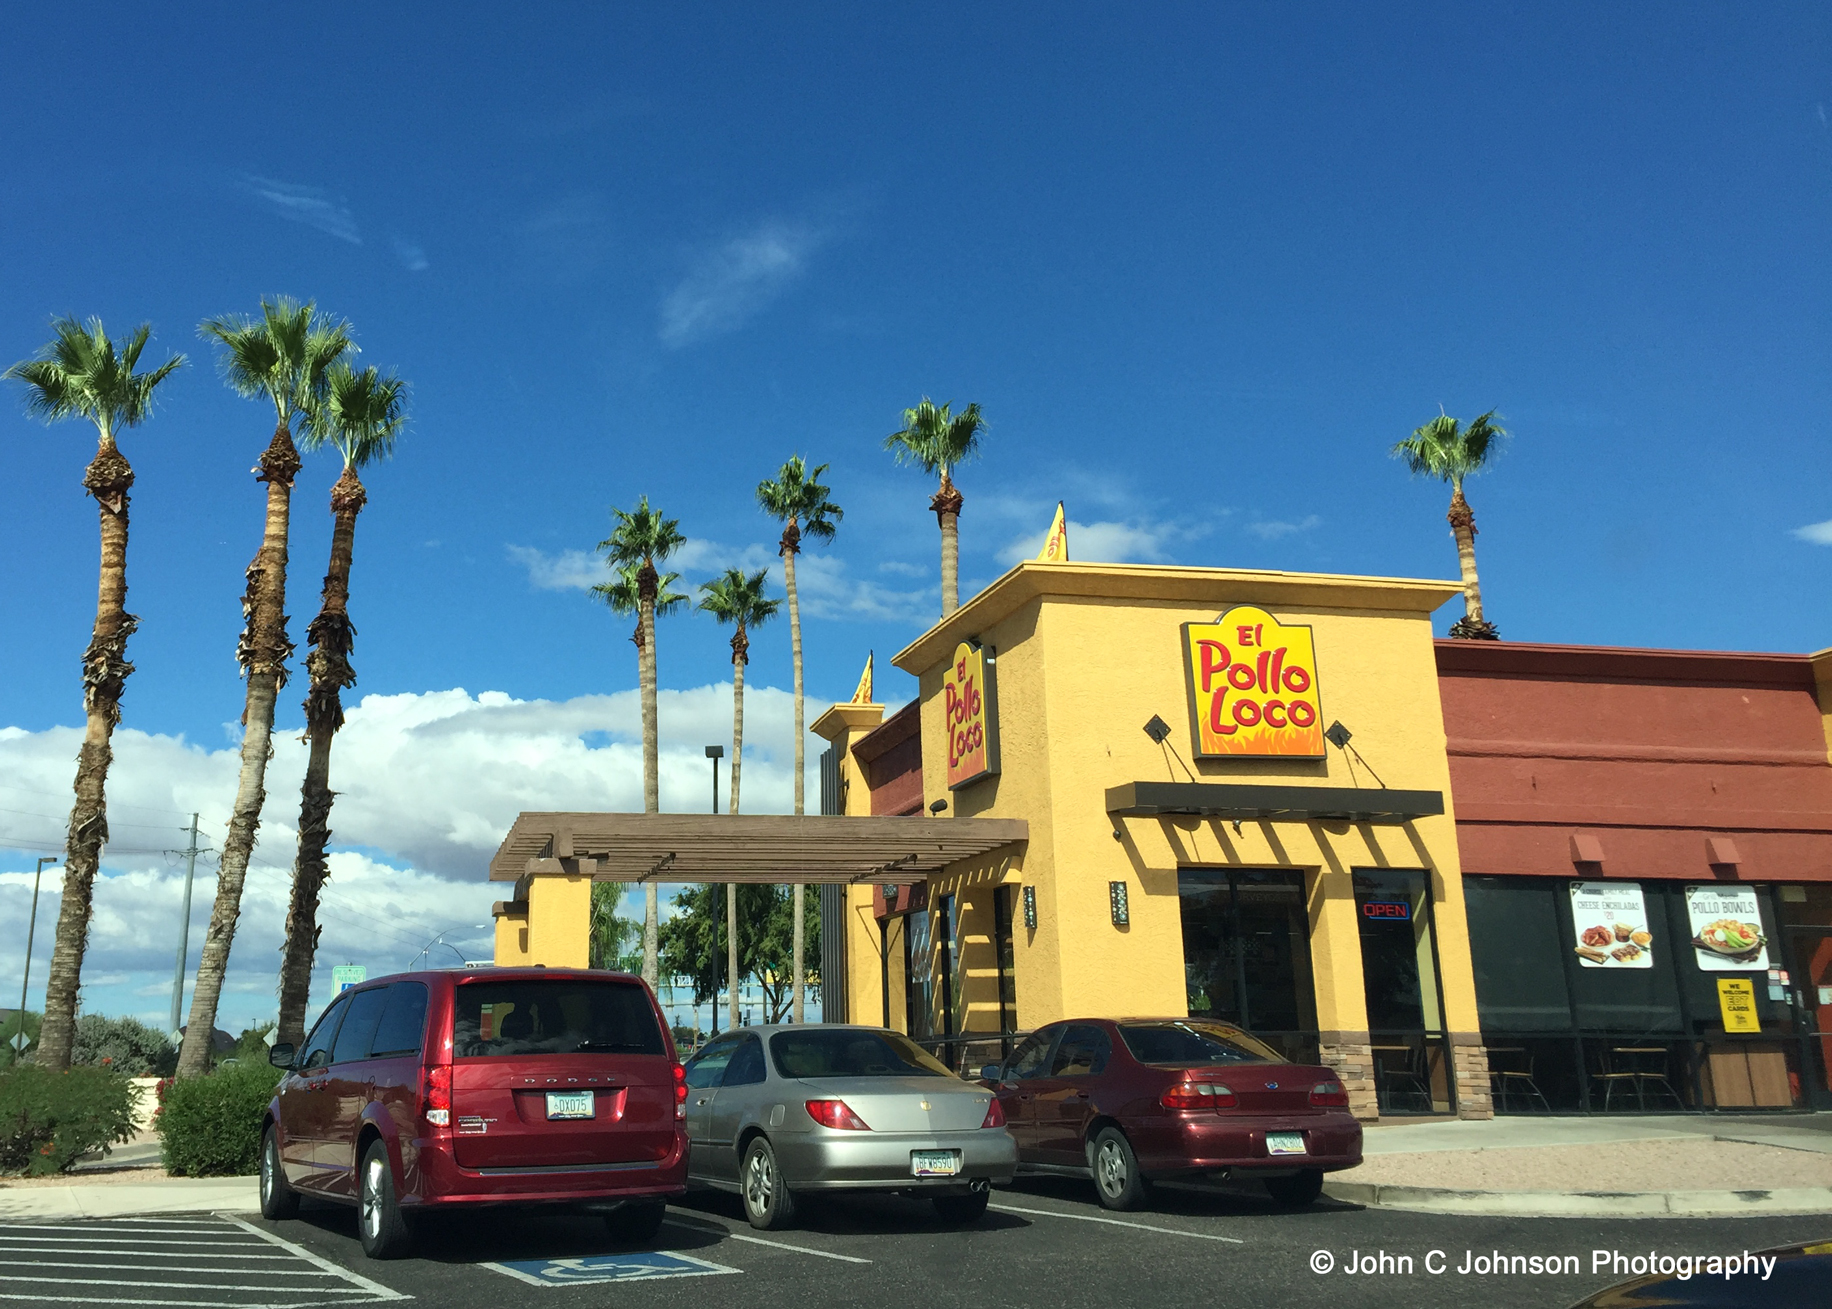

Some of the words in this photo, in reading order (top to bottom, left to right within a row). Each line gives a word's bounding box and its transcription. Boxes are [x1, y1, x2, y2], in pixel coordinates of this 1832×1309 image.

[1236, 623, 1264, 647] El
[957, 656, 966, 683] El
[1196, 639, 1311, 694] Pollo
[945, 674, 981, 732] Pollo
[1210, 686, 1316, 735] Loco
[1364, 904, 1406, 917] OPEN
[1577, 901, 1600, 909] CHEESE
[1602, 902, 1639, 910] ENCHILADAS
[1692, 901, 1719, 913] POLLO
[1722, 901, 1754, 913] BOWLS
[1726, 995, 1748, 1006] EBT
